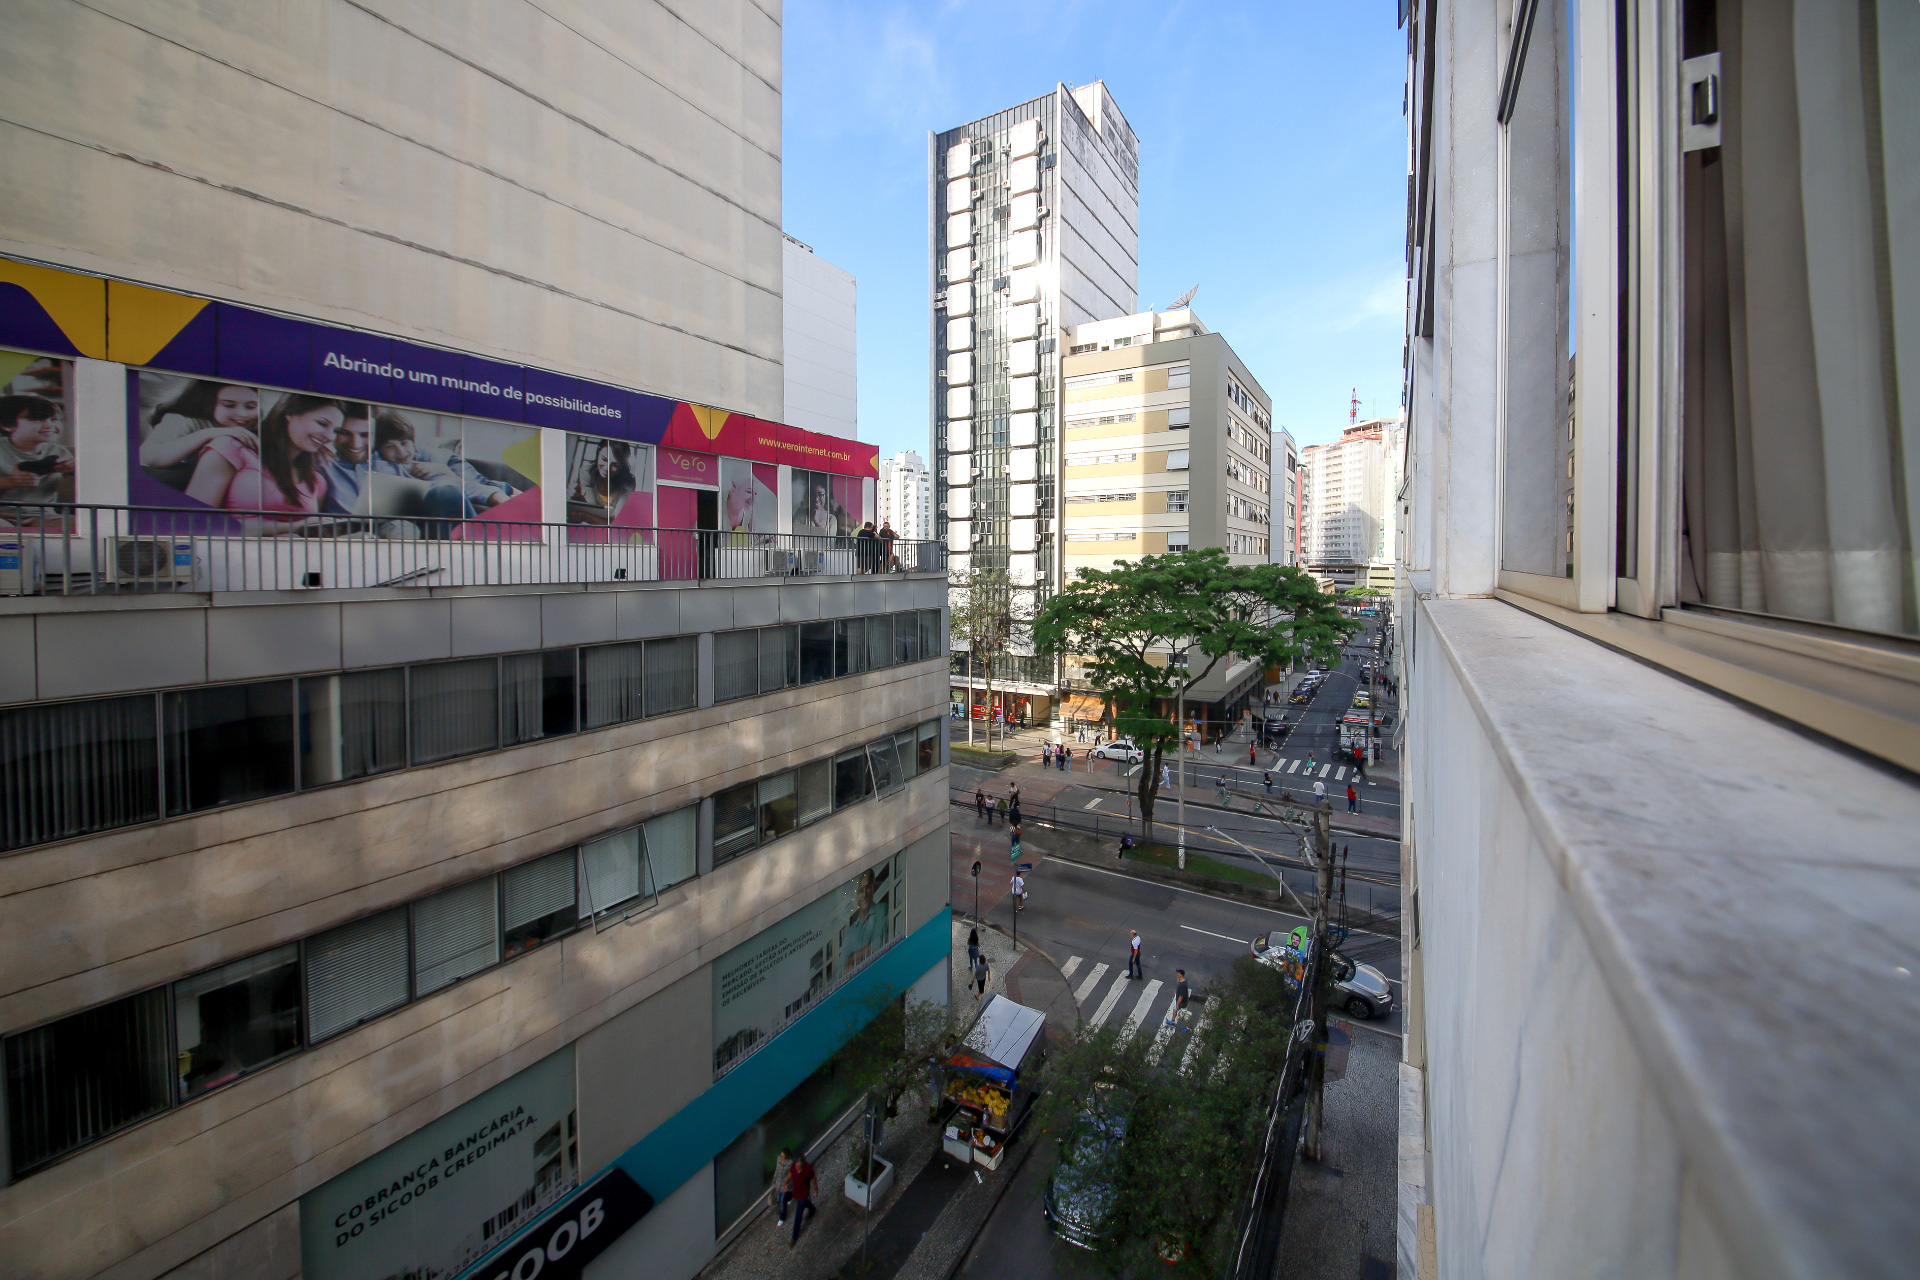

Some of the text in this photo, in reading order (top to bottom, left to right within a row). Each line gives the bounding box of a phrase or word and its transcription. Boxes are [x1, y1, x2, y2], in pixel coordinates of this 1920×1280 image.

[324, 352, 622, 419] Abrindo um mundo de possibilidades
[758, 436, 851, 462] www.verointernet.com.br
[722, 937, 788, 981] MELHORES TARIFAS DO
[750, 973, 758, 981] DE
[759, 956, 784, 975] BOLETOS
[755, 952, 777, 970] GESTÃO
[722, 997, 731, 1007] DE
[334, 1105, 525, 1228] COBRANÇA BANCÁRIA
[336, 1116, 538, 1248] DO SICOOB CREDIMATA.
[492, 1197, 605, 1280] OOB
